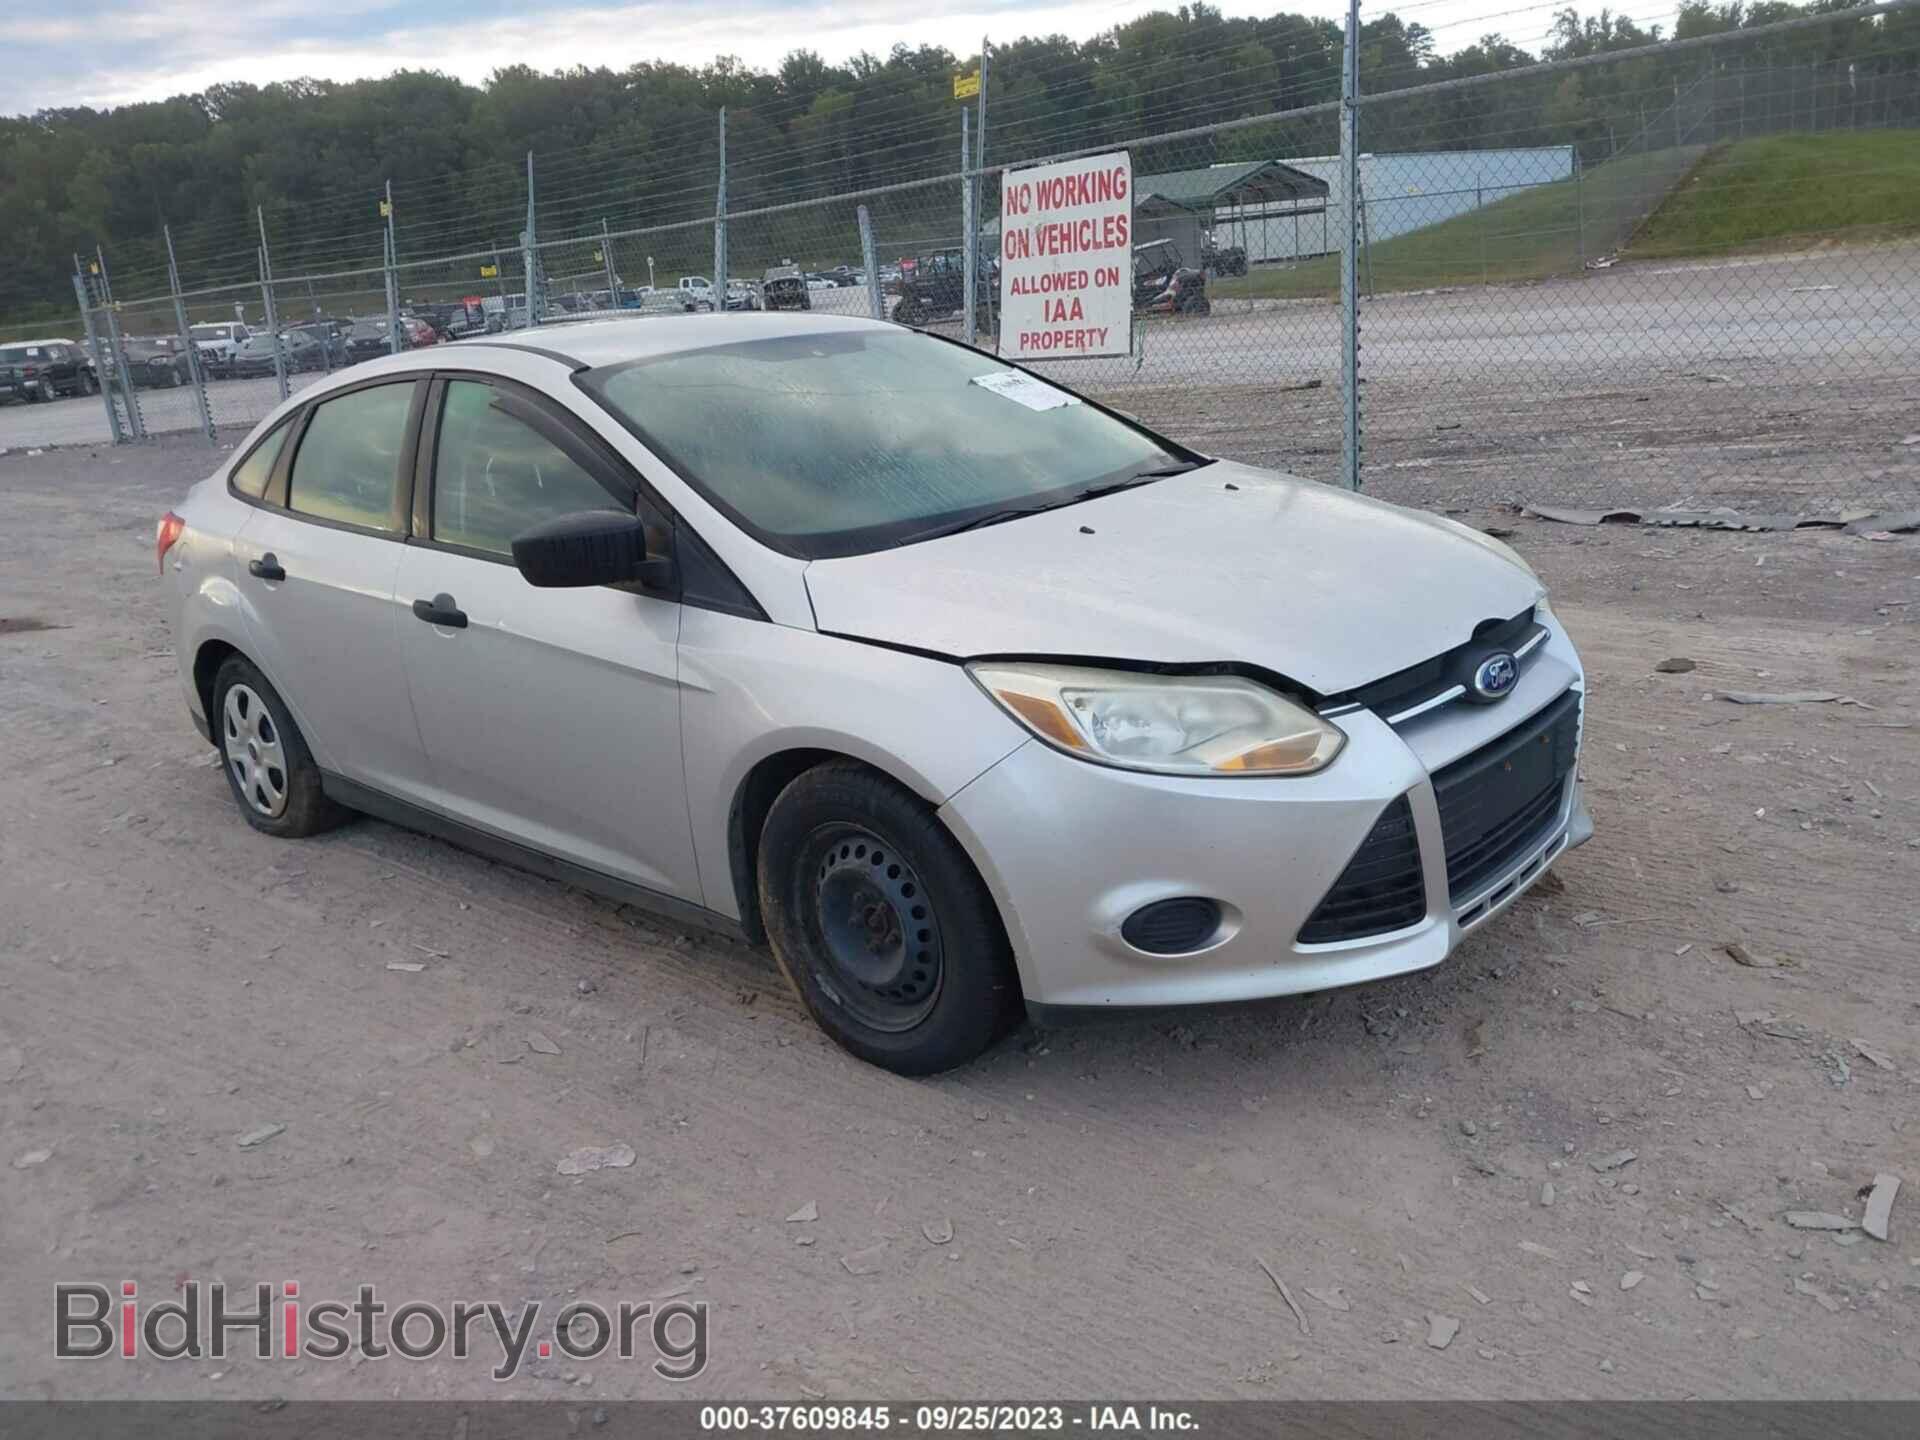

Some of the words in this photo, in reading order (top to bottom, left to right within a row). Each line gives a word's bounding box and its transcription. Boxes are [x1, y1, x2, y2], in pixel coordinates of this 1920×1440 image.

[1006, 183, 1031, 216] NO
[1036, 166, 1128, 211] WORKING
[1004, 228, 1029, 260] ON
[1035, 214, 1128, 257] VEHICLES
[1010, 269, 1089, 296] ALLOWED
[1094, 266, 1120, 288] ON
[1044, 297, 1085, 323] IAA
[1020, 327, 1109, 351] PROPERTY
[1488, 659, 1514, 689] Ford
